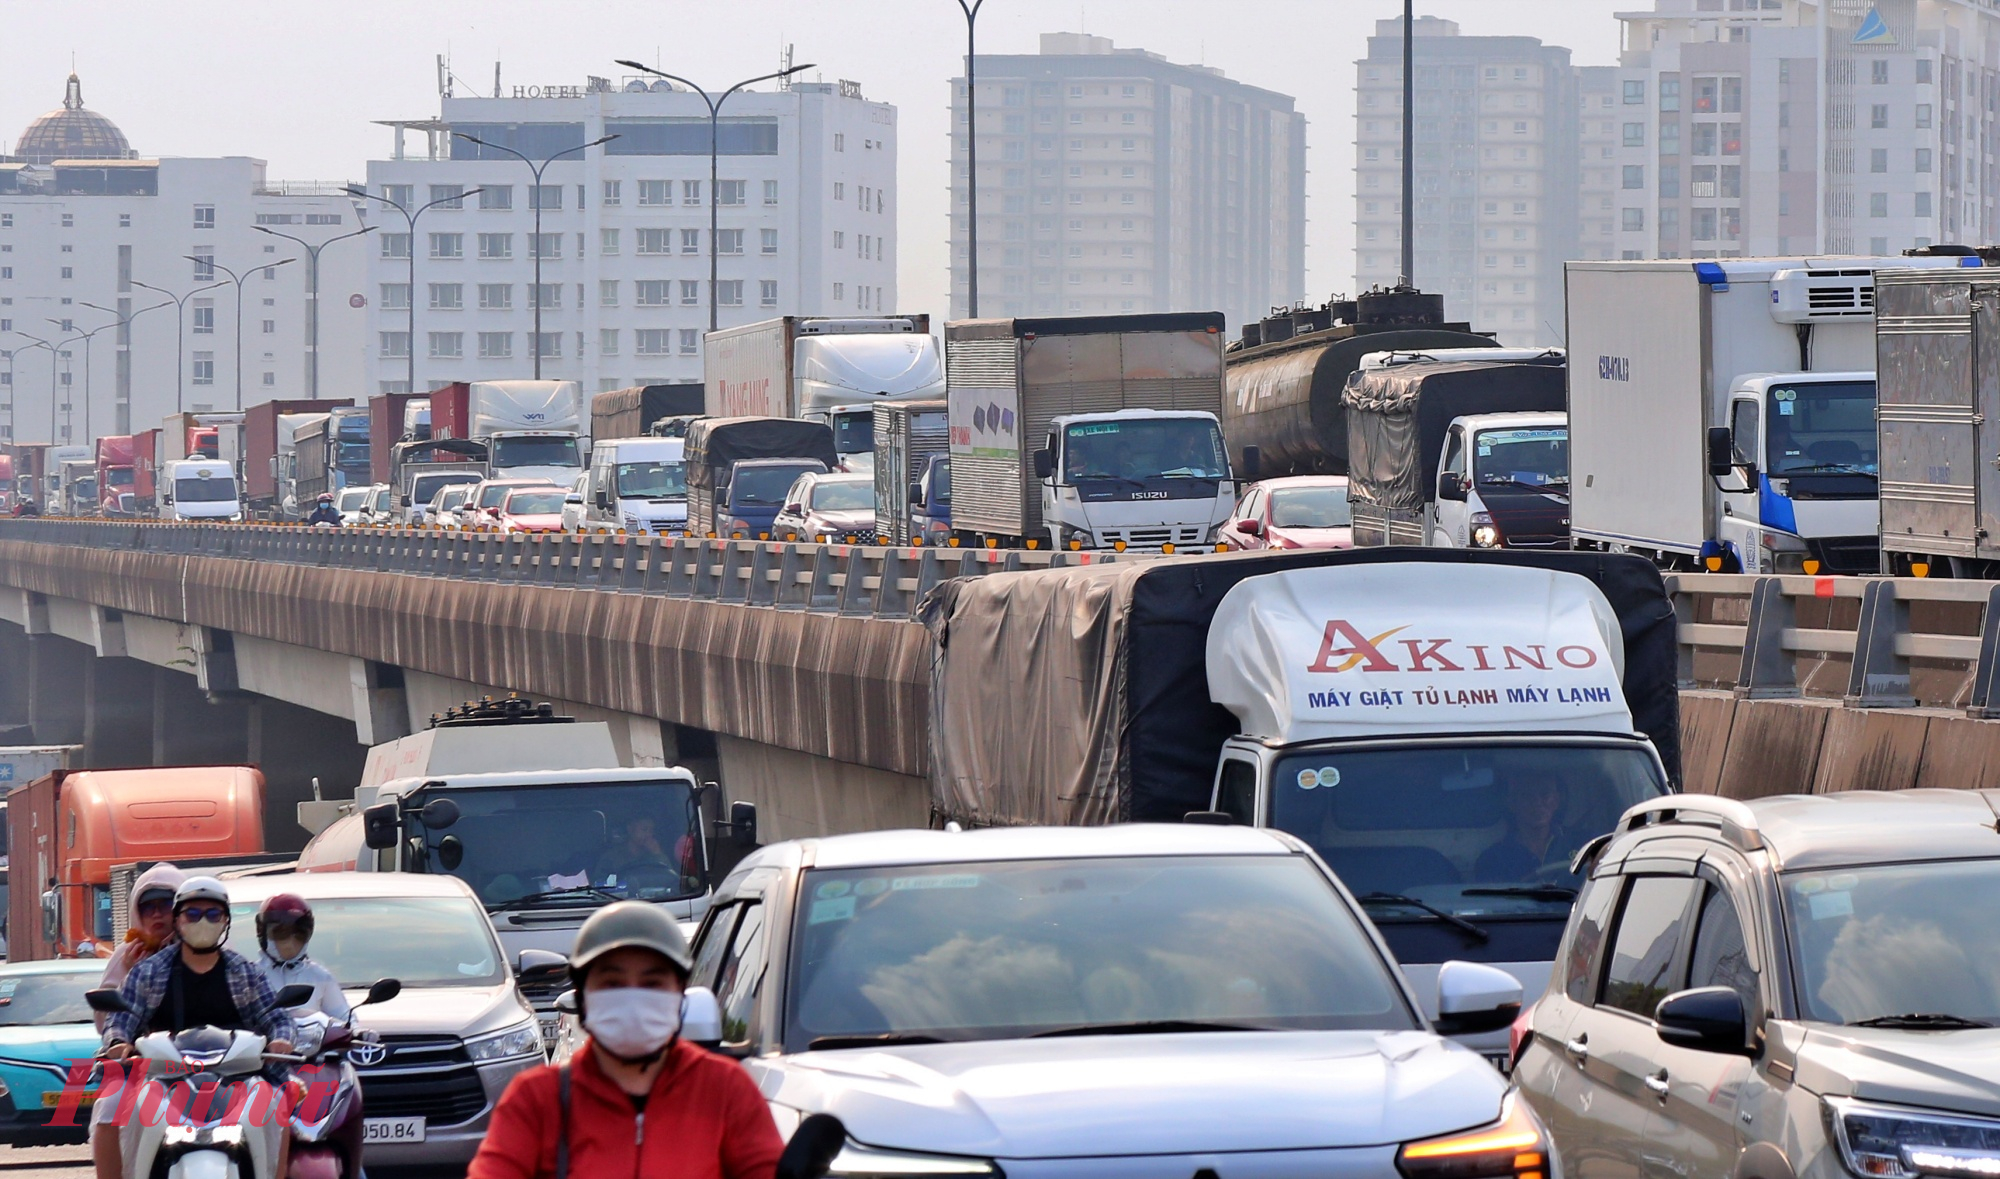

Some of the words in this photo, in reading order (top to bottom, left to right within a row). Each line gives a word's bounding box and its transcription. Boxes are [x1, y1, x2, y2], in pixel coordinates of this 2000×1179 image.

[513, 85, 582, 99] HOTEL
[727, 382, 748, 417] YANG
[750, 378, 769, 417] MING
[1131, 491, 1168, 499] ISUZU
[1307, 620, 1597, 673] AKINO
[1308, 688, 1351, 708] MÁY
[1360, 688, 1403, 709] GIẶT
[1412, 686, 1439, 705] TỦ
[1444, 689, 1498, 708] LẠNH
[1507, 684, 1549, 703] MÁY
[1557, 687, 1611, 706] LẠNH
